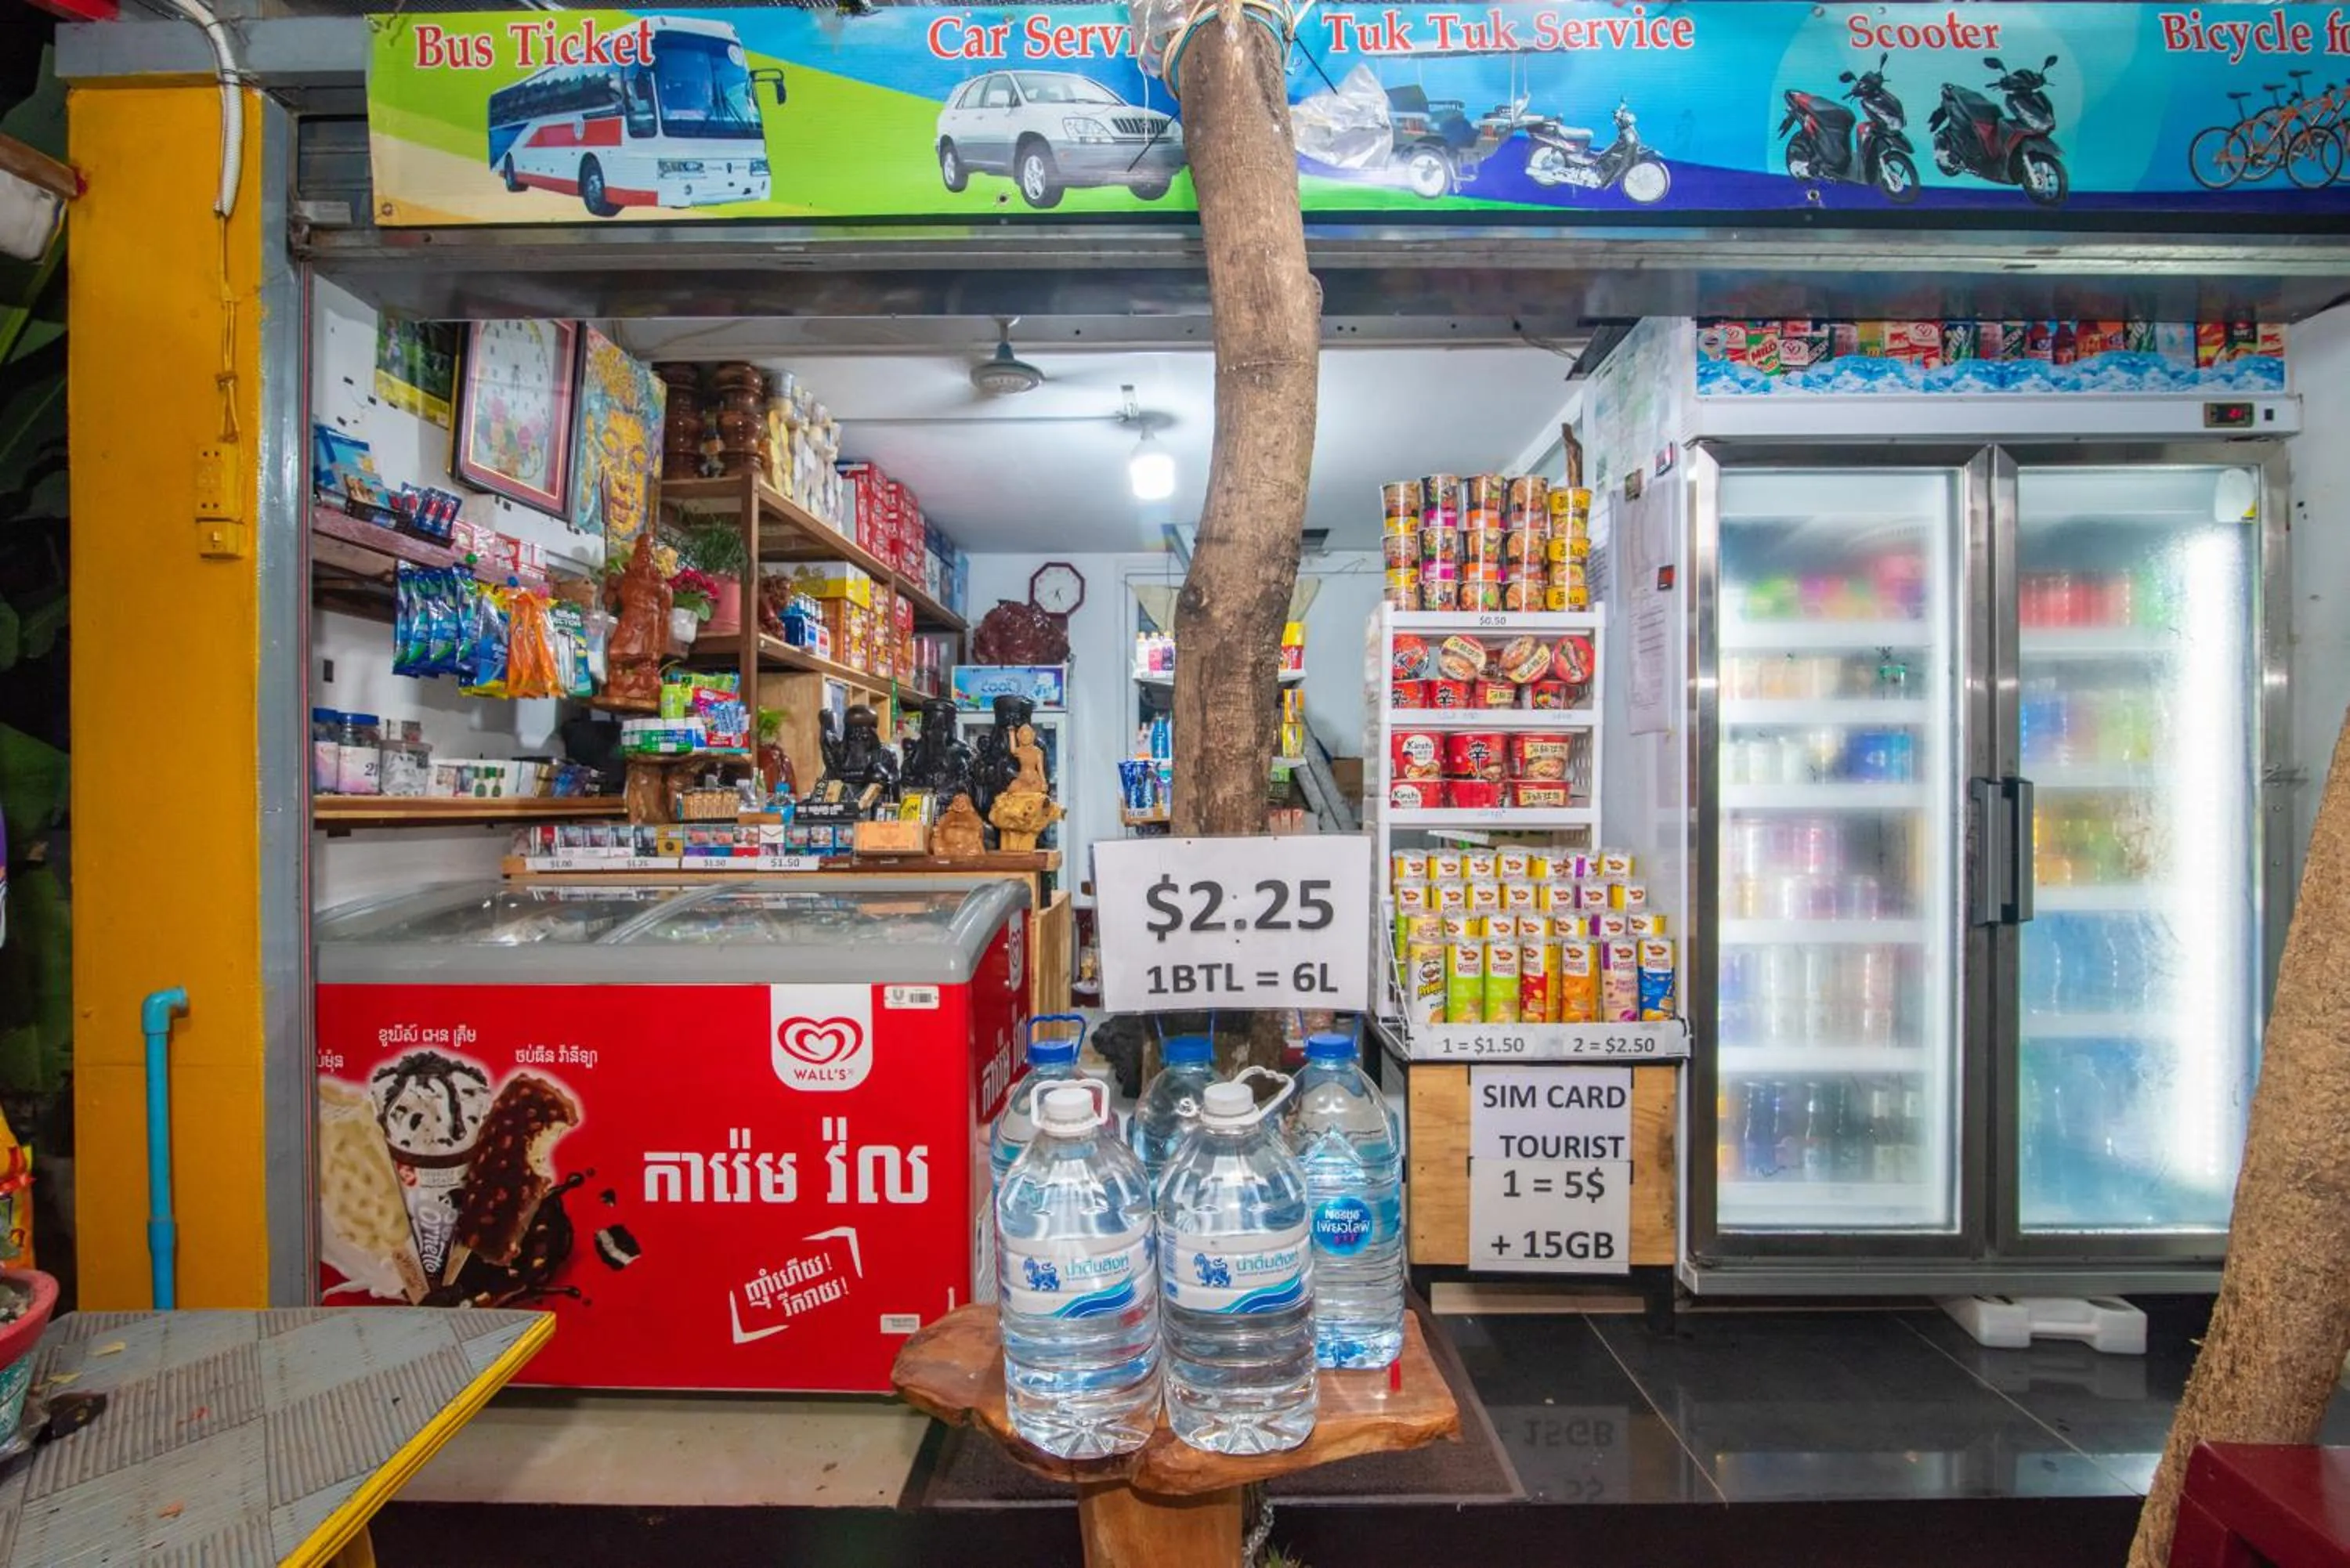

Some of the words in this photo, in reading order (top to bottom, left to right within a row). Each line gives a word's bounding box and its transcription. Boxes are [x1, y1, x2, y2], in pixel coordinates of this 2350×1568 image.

[414, 25, 494, 69] Bus
[509, 18, 655, 67] Ticket
[927, 16, 1010, 59] Car
[1024, 13, 1168, 59] Servi
[1321, 7, 1415, 52] Tuk
[1427, 5, 1520, 51] Tuk
[1533, 6, 1695, 50] Service
[1848, 12, 2002, 50] Scooter
[2158, 9, 2312, 65] Bicycle
[770, 858, 800, 868] $1.50
[1146, 873, 1334, 942] $2.25
[1147, 963, 1245, 994] 1BTL
[1292, 962, 1338, 993] 6L
[1443, 1037, 1453, 1053] 1
[1474, 1036, 1524, 1054] $1.50
[1573, 1037, 1584, 1053] 2
[1605, 1036, 1655, 1054] $2.50
[794, 1068, 847, 1081] WALL'S
[1482, 1085, 1536, 1108] SIM
[1546, 1085, 1626, 1109] CARD
[1499, 1135, 1625, 1159] TOURIST
[1503, 1169, 1521, 1198] 1
[1564, 1167, 1606, 1203] 5$
[1523, 1230, 1615, 1259] 15GB
